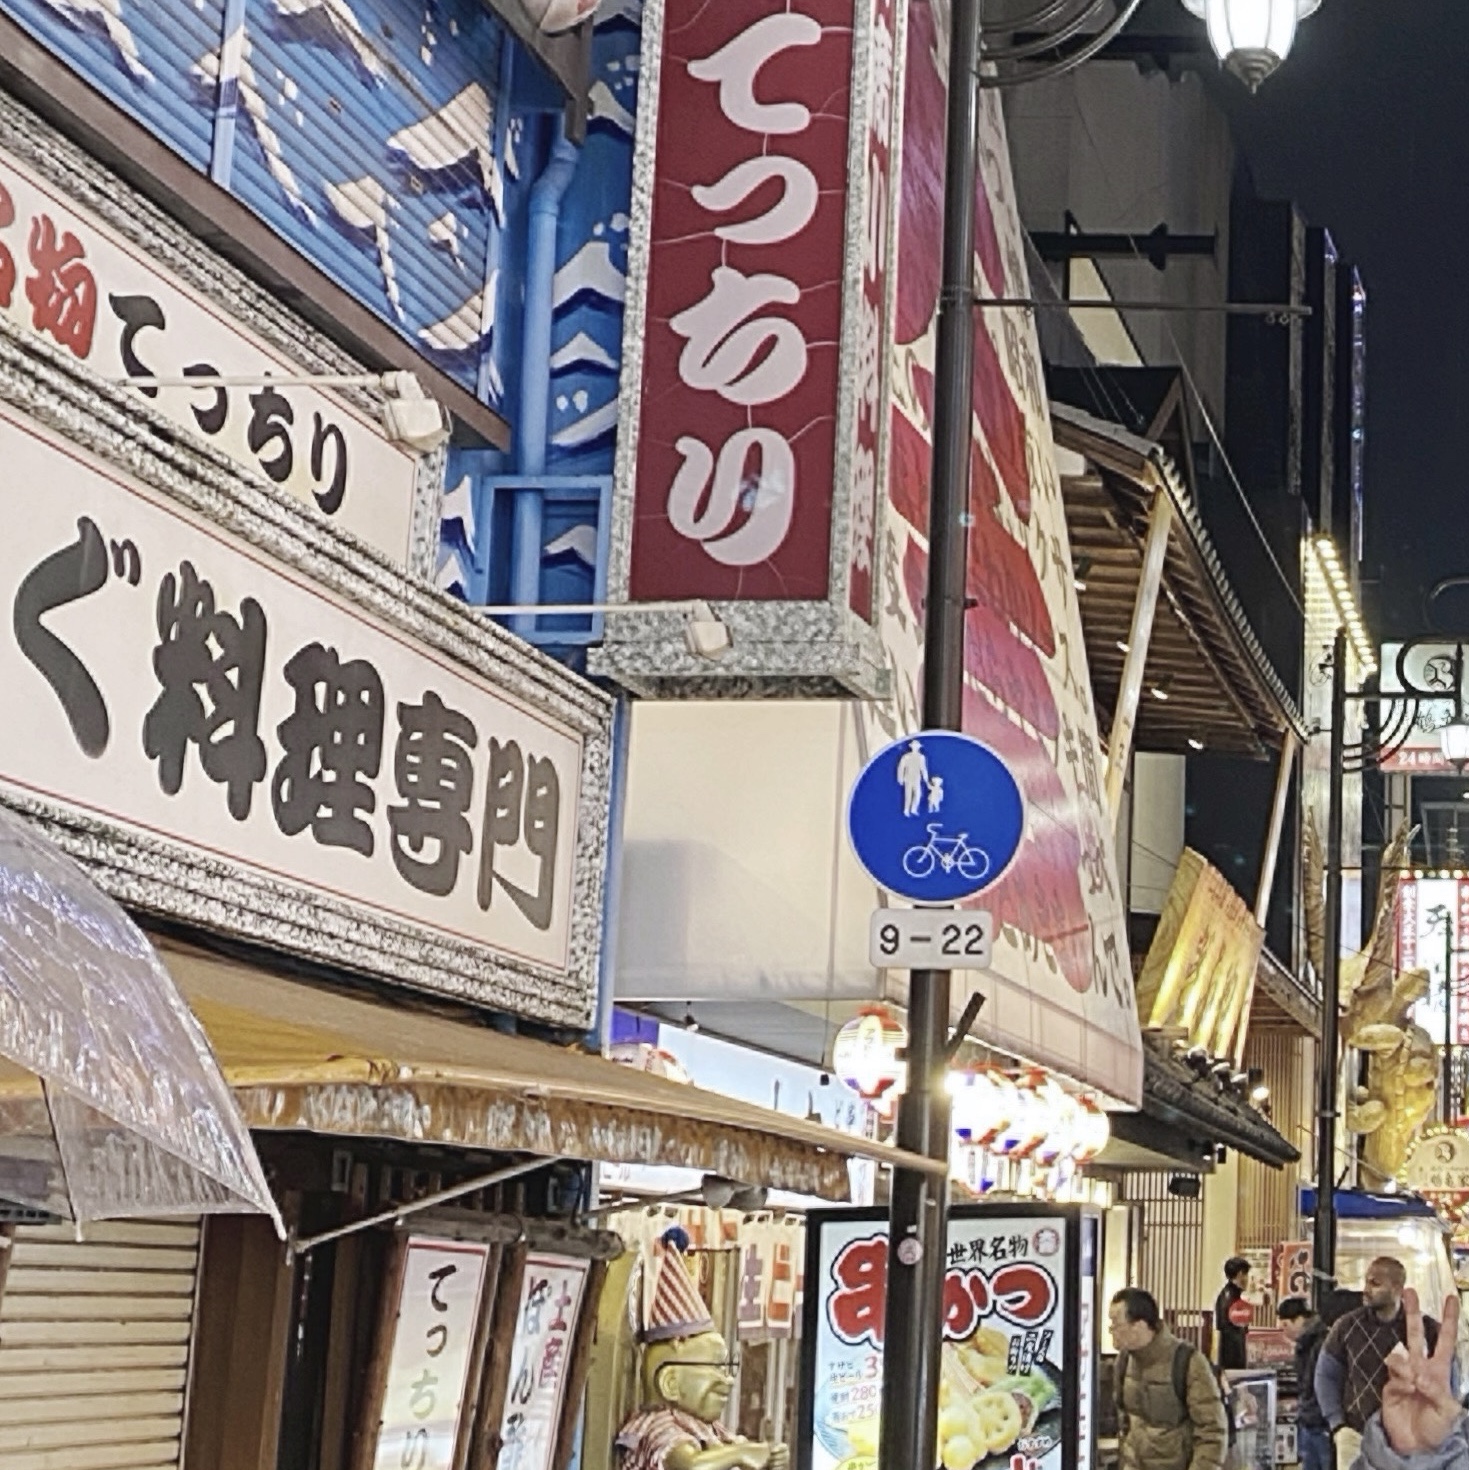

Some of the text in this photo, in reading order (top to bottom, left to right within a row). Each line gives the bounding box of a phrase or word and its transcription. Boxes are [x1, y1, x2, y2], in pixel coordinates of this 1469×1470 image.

[666, 12, 822, 566] てっちり
[13, 515, 560, 930] ぐ料理専門
[948, 1235, 1029, 1265] 世界名物
